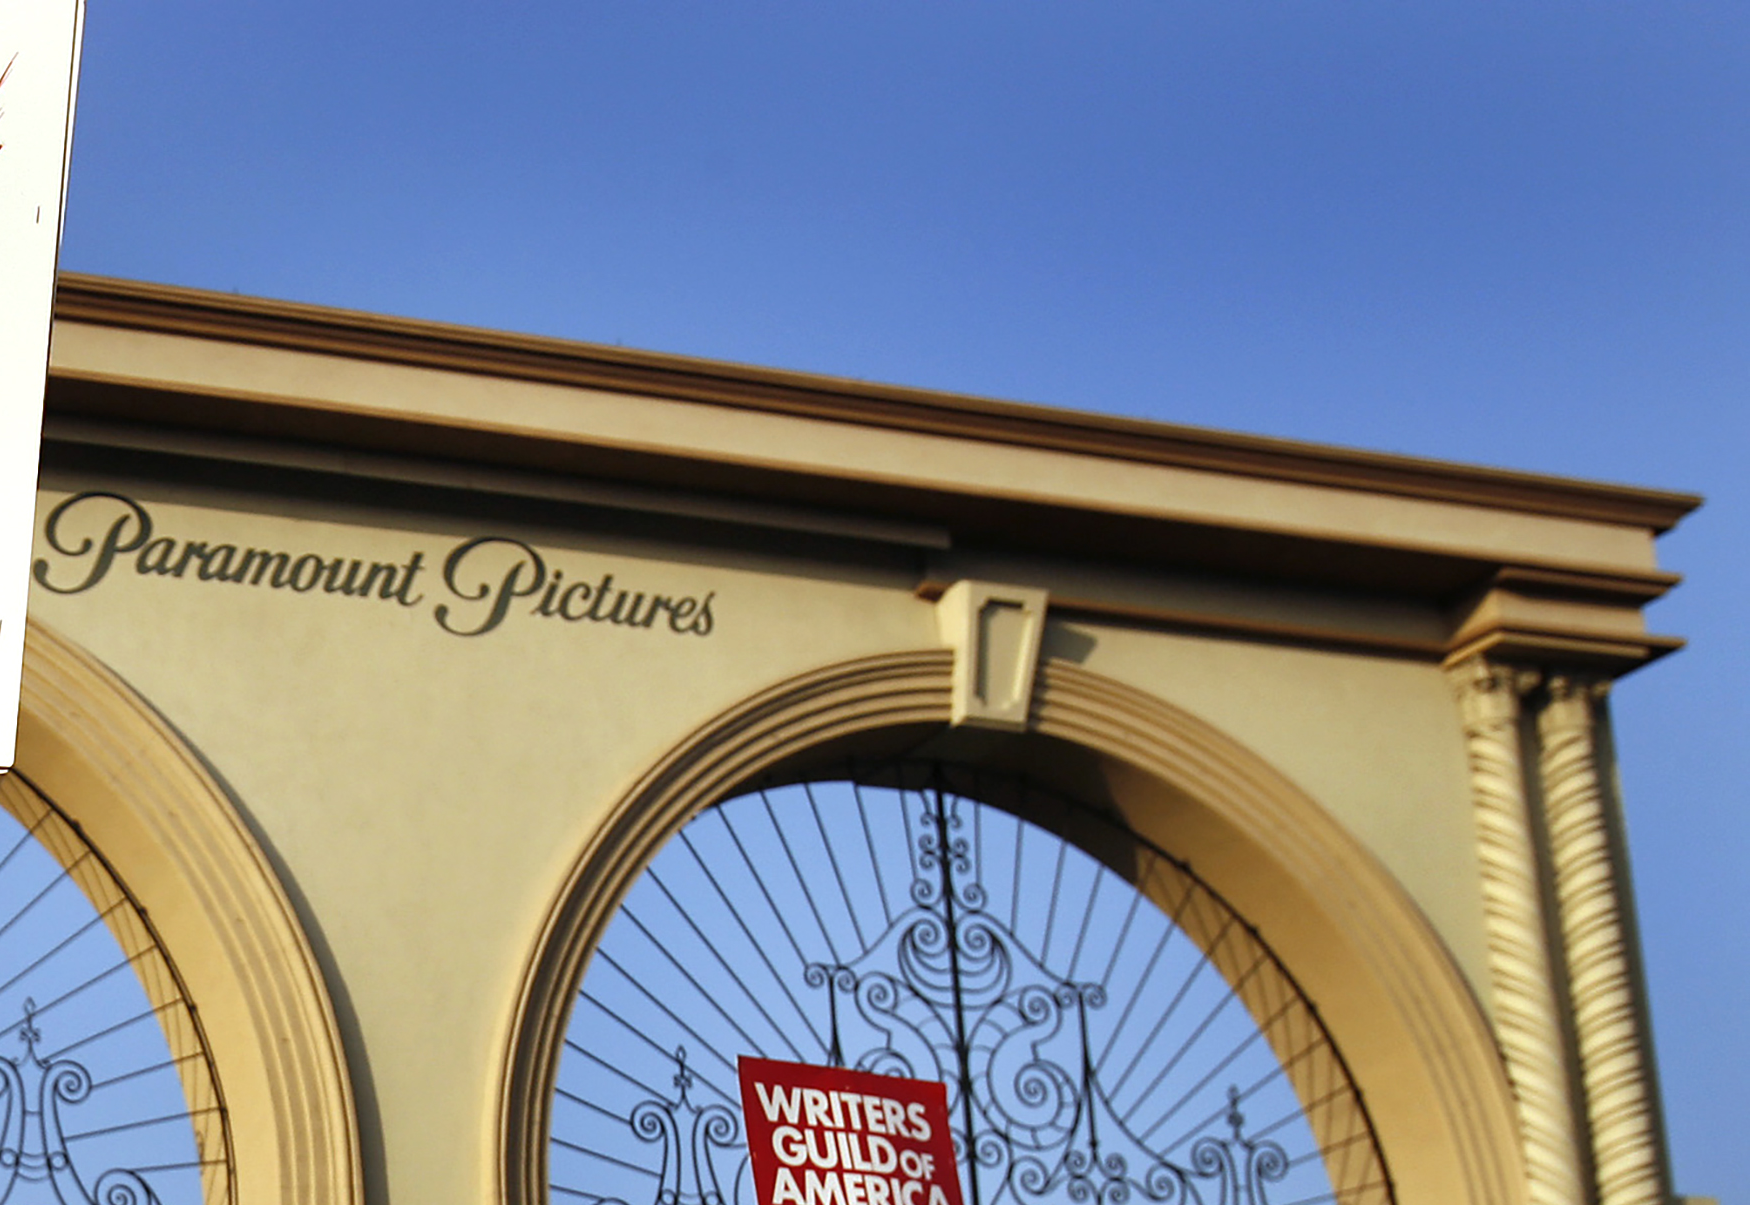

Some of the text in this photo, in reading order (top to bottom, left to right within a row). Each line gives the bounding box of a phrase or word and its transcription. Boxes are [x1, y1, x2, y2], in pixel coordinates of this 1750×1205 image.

[32, 491, 714, 637] Paramount Pictures
[754, 1082, 932, 1142] WRITERS
[772, 1125, 935, 1180] GUILD OF
